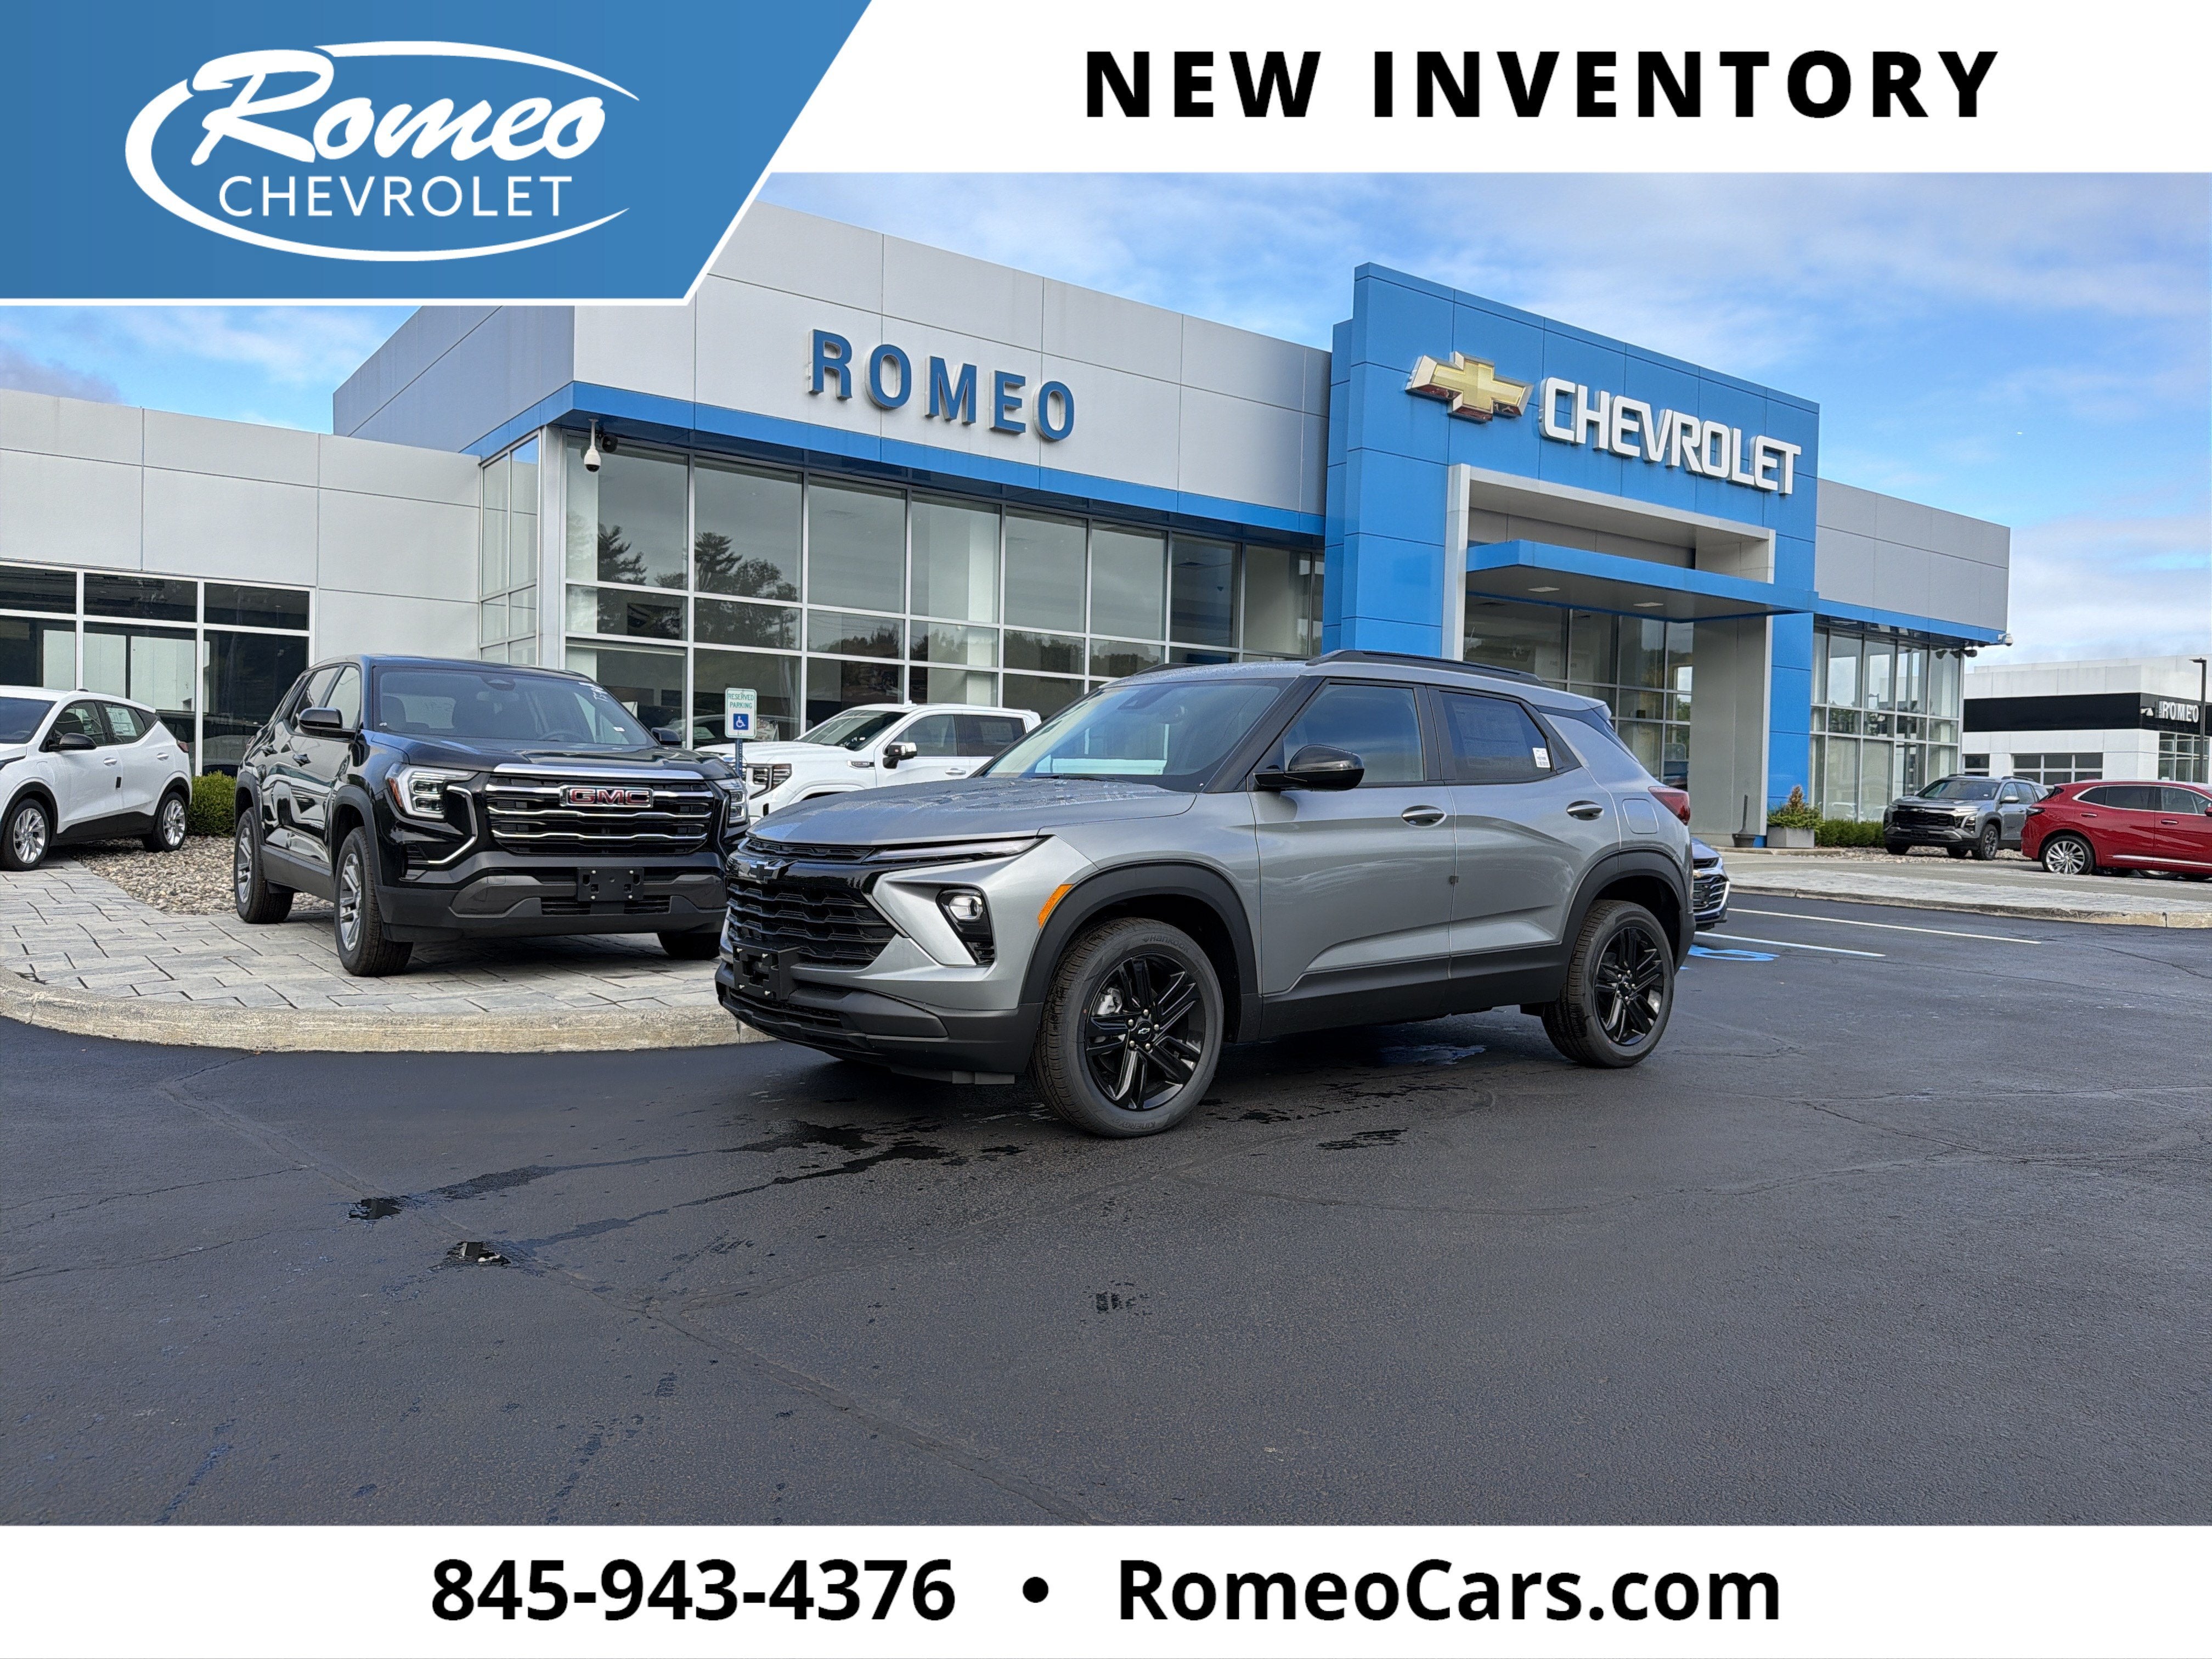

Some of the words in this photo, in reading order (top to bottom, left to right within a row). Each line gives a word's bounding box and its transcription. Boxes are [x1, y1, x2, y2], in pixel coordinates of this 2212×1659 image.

[809, 329, 1075, 441] ROMEO
[1539, 377, 1801, 494] CHEVROLET
[728, 693, 754, 701] RESERVED
[2160, 701, 2199, 723] ROMEO
[569, 788, 650, 805] GMC
